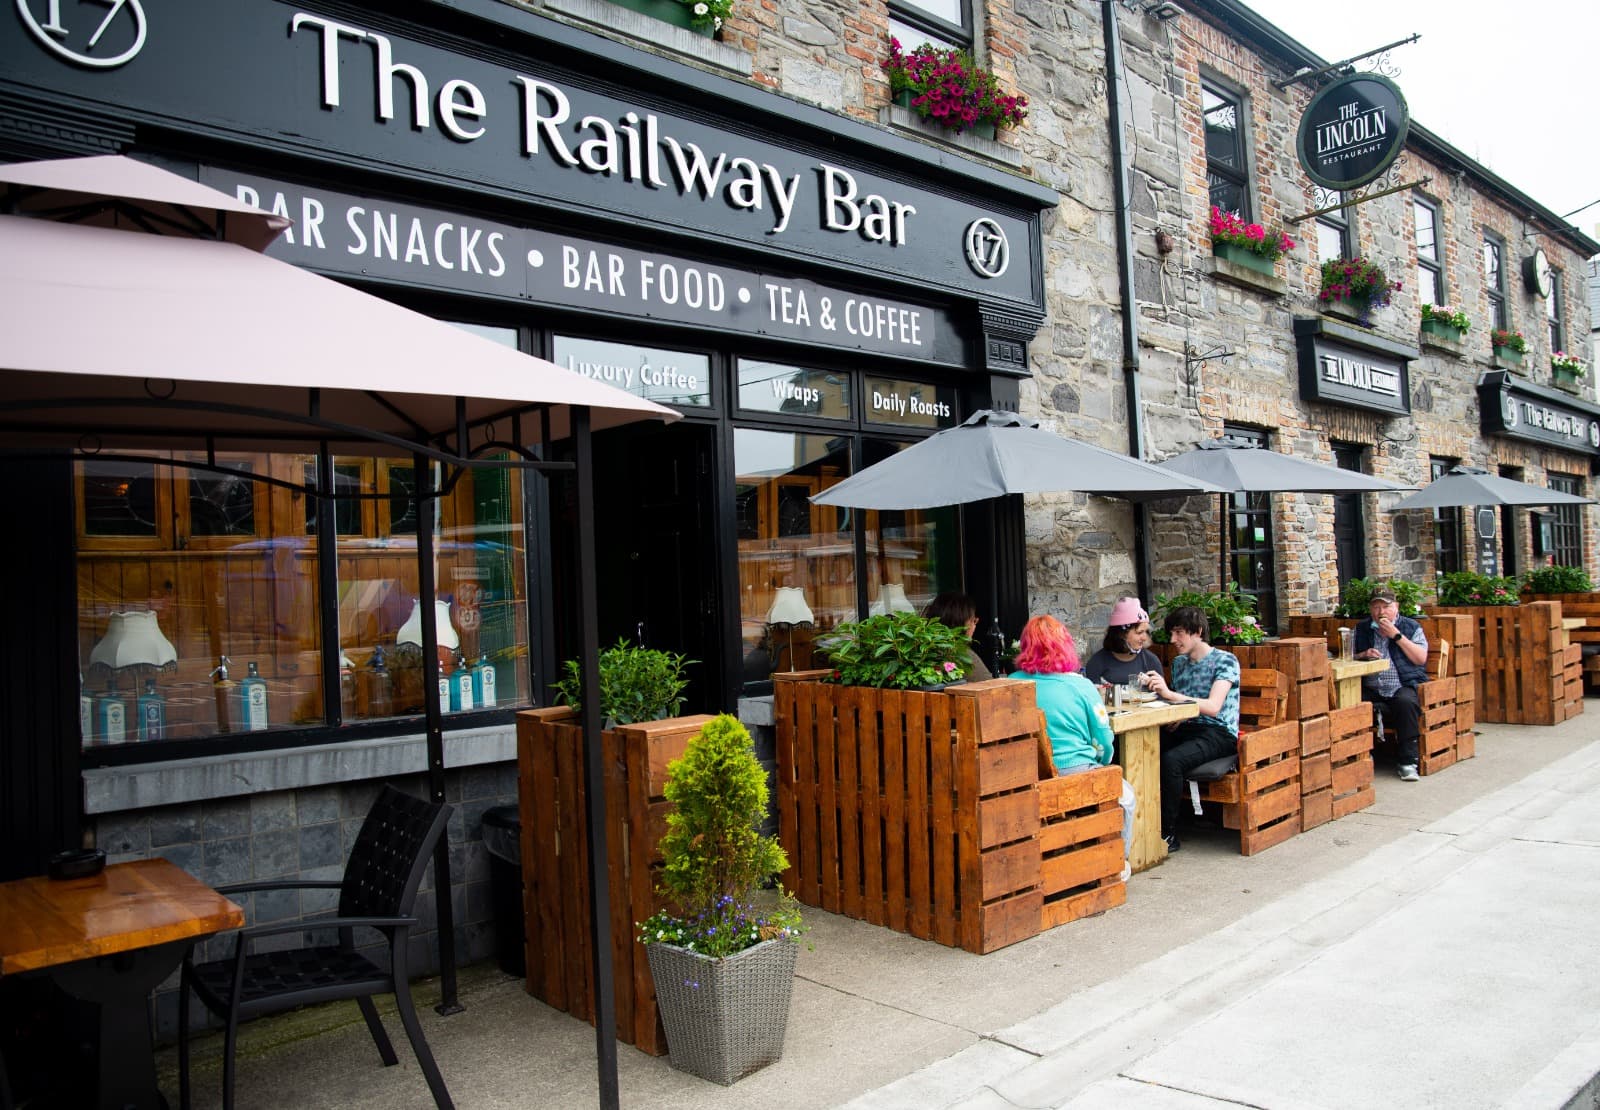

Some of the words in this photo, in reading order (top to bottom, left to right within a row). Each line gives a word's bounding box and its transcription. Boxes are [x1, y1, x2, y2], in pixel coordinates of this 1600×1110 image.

[291, 12, 487, 140] The
[515, 74, 799, 234] Railway
[818, 163, 916, 246] Bar
[1338, 101, 1359, 121] THE
[1316, 110, 1386, 153] LINCOLN
[1323, 143, 1381, 165] RESTAURANT
[974, 230, 1004, 266] 17
[347, 205, 506, 278] SNACKS
[562, 246, 627, 298] BAR
[641, 260, 726, 313] FOOD
[765, 283, 811, 327] TEA
[819, 300, 837, 329] &
[845, 299, 922, 346] COFFEE
[568, 354, 634, 388] Luxury
[640, 364, 698, 391] Coffee
[772, 379, 819, 406] Wraps
[873, 391, 907, 416] Daily
[910, 396, 951, 418] Roasts
[1525, 402, 1542, 426] The
[1542, 407, 1571, 440] Railway
[1571, 416, 1584, 438] Bar
